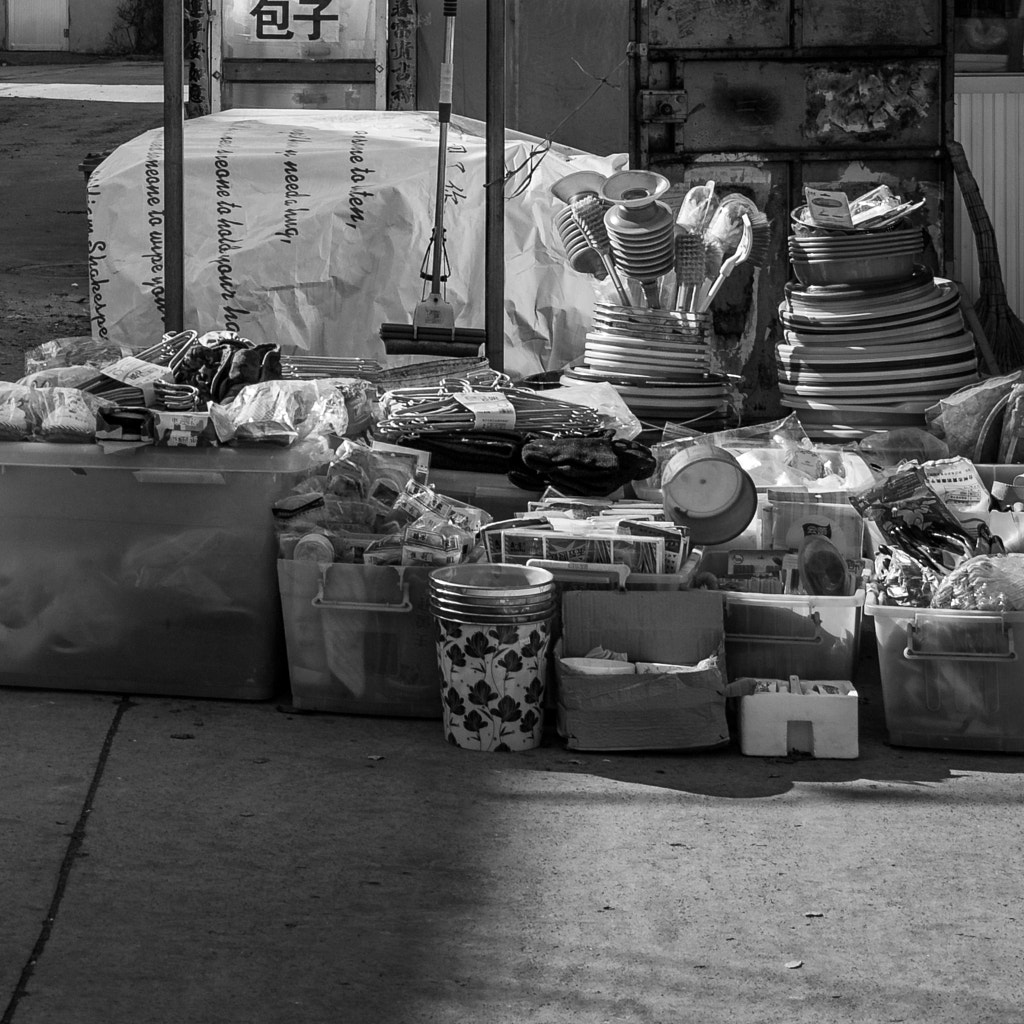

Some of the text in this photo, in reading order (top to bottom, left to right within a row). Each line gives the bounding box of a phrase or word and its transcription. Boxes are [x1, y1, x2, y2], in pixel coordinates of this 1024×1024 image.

[283, 160, 311, 198] need
[216, 202, 243, 215] to
[141, 230, 164, 273] wipe
[217, 218, 245, 254] hold
[208, 254, 237, 301] your
